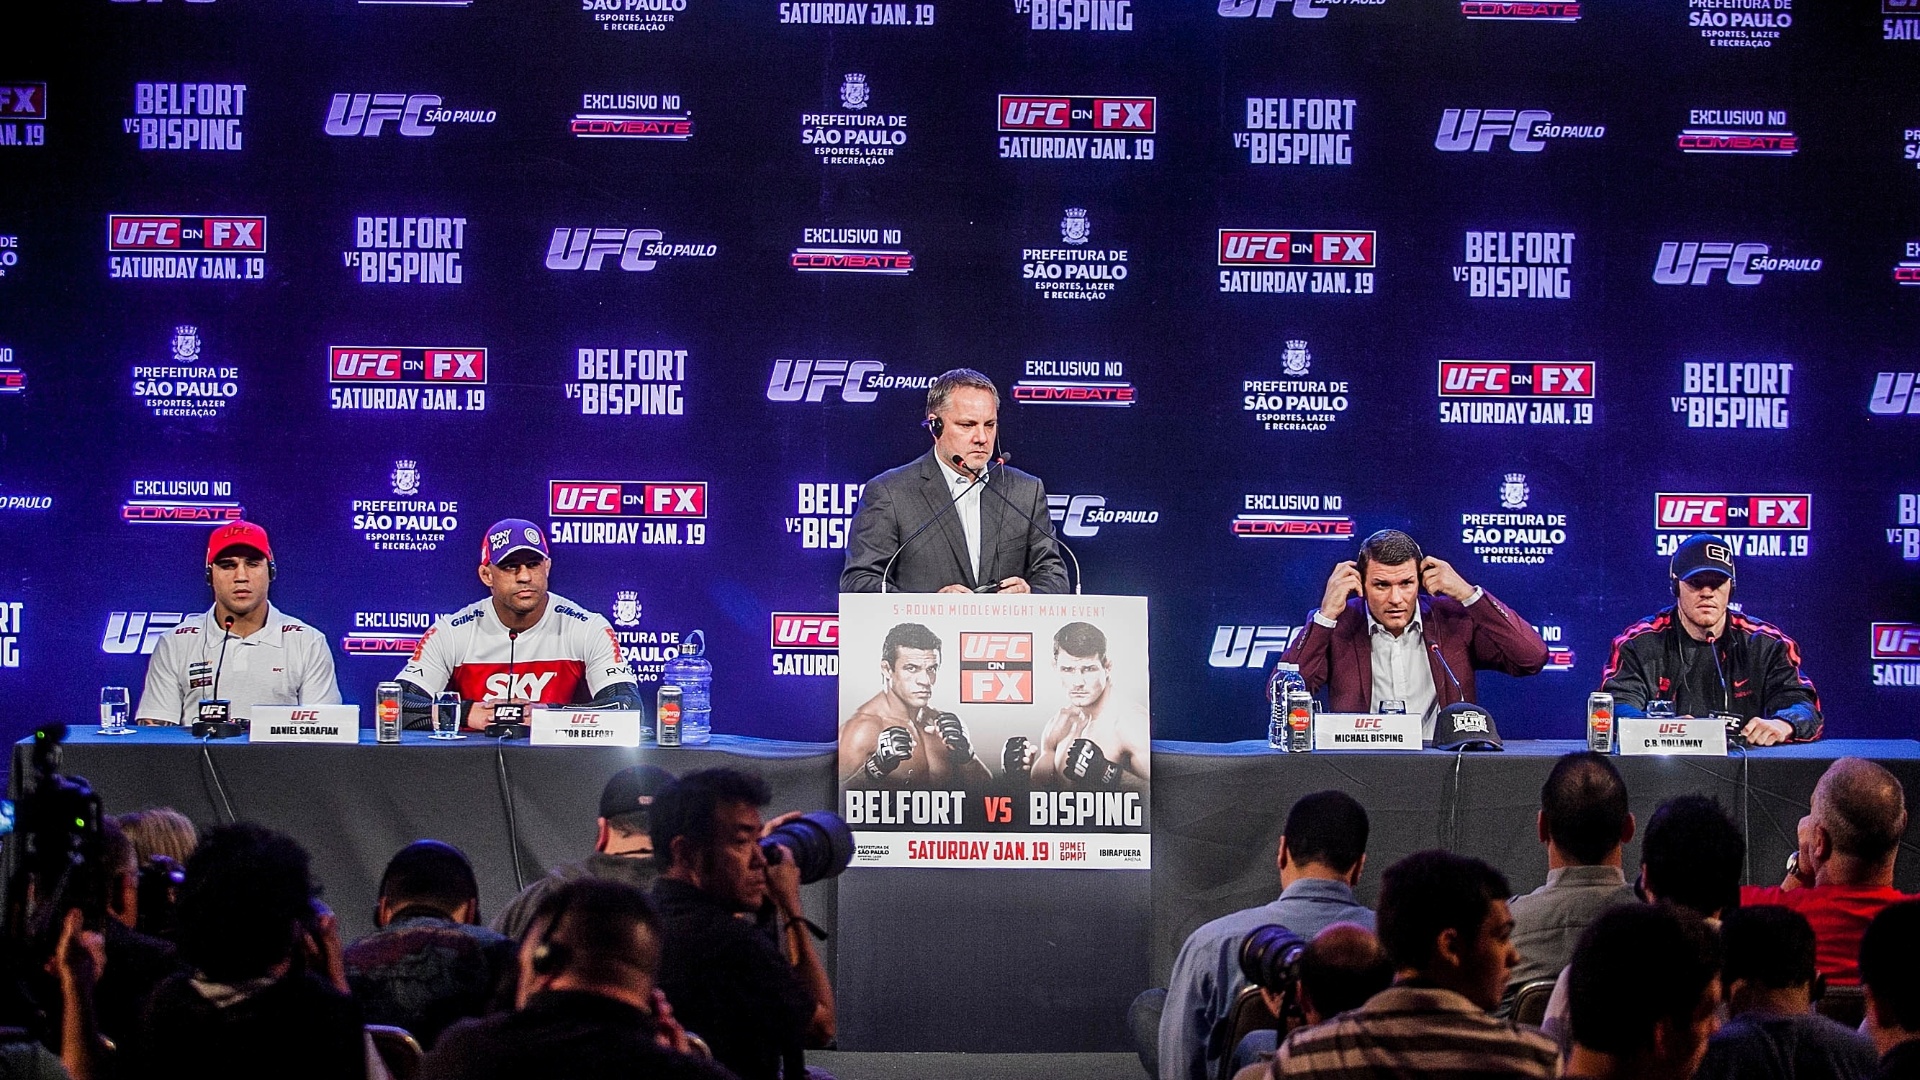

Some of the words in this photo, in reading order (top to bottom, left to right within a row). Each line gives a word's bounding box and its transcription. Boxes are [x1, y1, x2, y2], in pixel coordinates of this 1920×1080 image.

[137, 83, 246, 115] BELFORT
[583, 94, 657, 110] EXCLUSIVO
[662, 95, 680, 110] NO
[325, 93, 442, 137] UFC
[424, 107, 450, 123] SÃO
[452, 110, 497, 123] PAULO
[802, 114, 885, 126] PREFEITURA
[889, 115, 907, 127] DE
[1005, 102, 1067, 125] UFC
[1072, 110, 1092, 119] ON
[1103, 103, 1145, 127] FX
[1247, 98, 1356, 130] BELFORT
[1689, 109, 1763, 125] EXCLUSIVO
[1768, 110, 1786, 125] NO
[124, 118, 139, 133] VS
[141, 118, 242, 150] BISPING
[570, 120, 691, 134] COMBATE
[802, 126, 841, 144] SÃO
[844, 129, 907, 145] PAULO
[1434, 109, 1551, 153] UFC
[1533, 123, 1559, 139] SÃO
[1561, 126, 1606, 139] PAULO
[1000, 136, 1088, 159] SATURDAY
[1091, 138, 1131, 160] JAN.
[1135, 139, 1154, 160] 19
[1234, 133, 1249, 148] VS
[1251, 133, 1352, 165] BISPING
[1676, 135, 1797, 149] COMBATE
[865, 148, 894, 156] LAZER
[116, 222, 178, 245] UFC
[183, 230, 203, 239] ON
[214, 223, 256, 247] FX
[357, 216, 466, 248] BELFORT
[804, 228, 878, 244] EXCLUSIVO
[883, 229, 901, 244] NO
[546, 227, 663, 271] UFC
[645, 241, 671, 257] SÃO
[673, 244, 718, 257] PAULO
[1225, 236, 1287, 259] UFC
[1292, 244, 1312, 253] ON
[1323, 237, 1365, 261] FX
[1466, 231, 1575, 263] BELFORT
[111, 256, 199, 279] SATURDAY
[202, 258, 242, 280] JAN.
[246, 259, 265, 280] 19
[344, 251, 359, 266] VS
[361, 251, 462, 283] BISPING
[791, 254, 912, 268] COMBATE
[1652, 242, 1769, 286] UFC
[1751, 256, 1777, 272] SÃO
[1779, 259, 1824, 272] PAULO
[1220, 270, 1308, 293] SATURDAY
[1311, 272, 1351, 294] JAN.
[1355, 273, 1374, 294] 19
[1453, 266, 1468, 281] VS
[1470, 266, 1571, 298] BISPING
[134, 366, 217, 378] PREFEITURA
[221, 367, 239, 379] DE
[336, 353, 398, 376] UFC
[403, 361, 423, 370] ON
[434, 354, 476, 378] FX
[578, 348, 687, 380] BELFORT
[134, 378, 173, 396] SÃO
[176, 381, 239, 397] PAULO
[1684, 362, 1793, 394] BELFORT
[197, 400, 226, 408] LAZER
[331, 387, 419, 410] SATURDAY
[422, 389, 462, 411] JAN.
[466, 390, 485, 411] 19
[565, 383, 580, 398] VS
[582, 383, 683, 415] BISPING
[1671, 397, 1686, 412] VS
[1688, 397, 1789, 429] BISPING
[135, 480, 209, 496] EXCLUSIVO
[214, 481, 232, 496] NO
[556, 487, 618, 510] UFC
[623, 495, 643, 504] ON
[654, 488, 696, 512] FX
[1245, 494, 1319, 510] EXCLUSIVO
[1324, 495, 1342, 510] NO
[122, 506, 243, 520] COMBATE
[1462, 513, 1545, 525] PREFEITURA
[1549, 514, 1567, 526] DE
[551, 521, 639, 544] SATURDAY
[642, 523, 682, 545] JAN.
[686, 524, 705, 545] 19
[1232, 520, 1353, 534] COMBATE
[1462, 525, 1501, 543] SÃO
[1504, 528, 1567, 544] PAULO
[1525, 547, 1554, 555] LAZER
[451, 609, 485, 627] Gillette
[554, 604, 588, 622] Gillette
[894, 604, 944, 616] 5-ROUND
[949, 605, 1034, 616] MIDDLEWEIGHT
[1039, 605, 1067, 616] MAIN
[1072, 606, 1105, 617] EVENT
[175, 626, 200, 635] UFC
[282, 625, 306, 633] UFC
[964, 636, 1029, 659] UFC
[987, 662, 1005, 670] ON
[482, 672, 557, 702] SKY
[972, 672, 1024, 701] FX
[201, 705, 226, 715] UFC
[291, 711, 320, 720] UFC
[495, 707, 521, 717] UFC
[571, 714, 600, 723] UFC
[270, 727, 298, 735] DANIEL
[299, 727, 339, 735] SARAFIAN
[1354, 718, 1383, 728] UFC
[1659, 723, 1687, 733] UFC
[555, 729, 579, 738] TOR
[1334, 734, 1369, 742] MICHAEL
[1371, 734, 1404, 743] BISPING
[1074, 740, 1094, 778] UFC
[846, 790, 966, 825] BELFORT
[984, 797, 1012, 823] VS
[1029, 791, 1142, 827] BISPING
[908, 840, 989, 860] SATURDAY
[993, 841, 1029, 861] JAN.
[1032, 841, 1049, 861] 19
[1099, 849, 1141, 857] IBIRAPUERA
